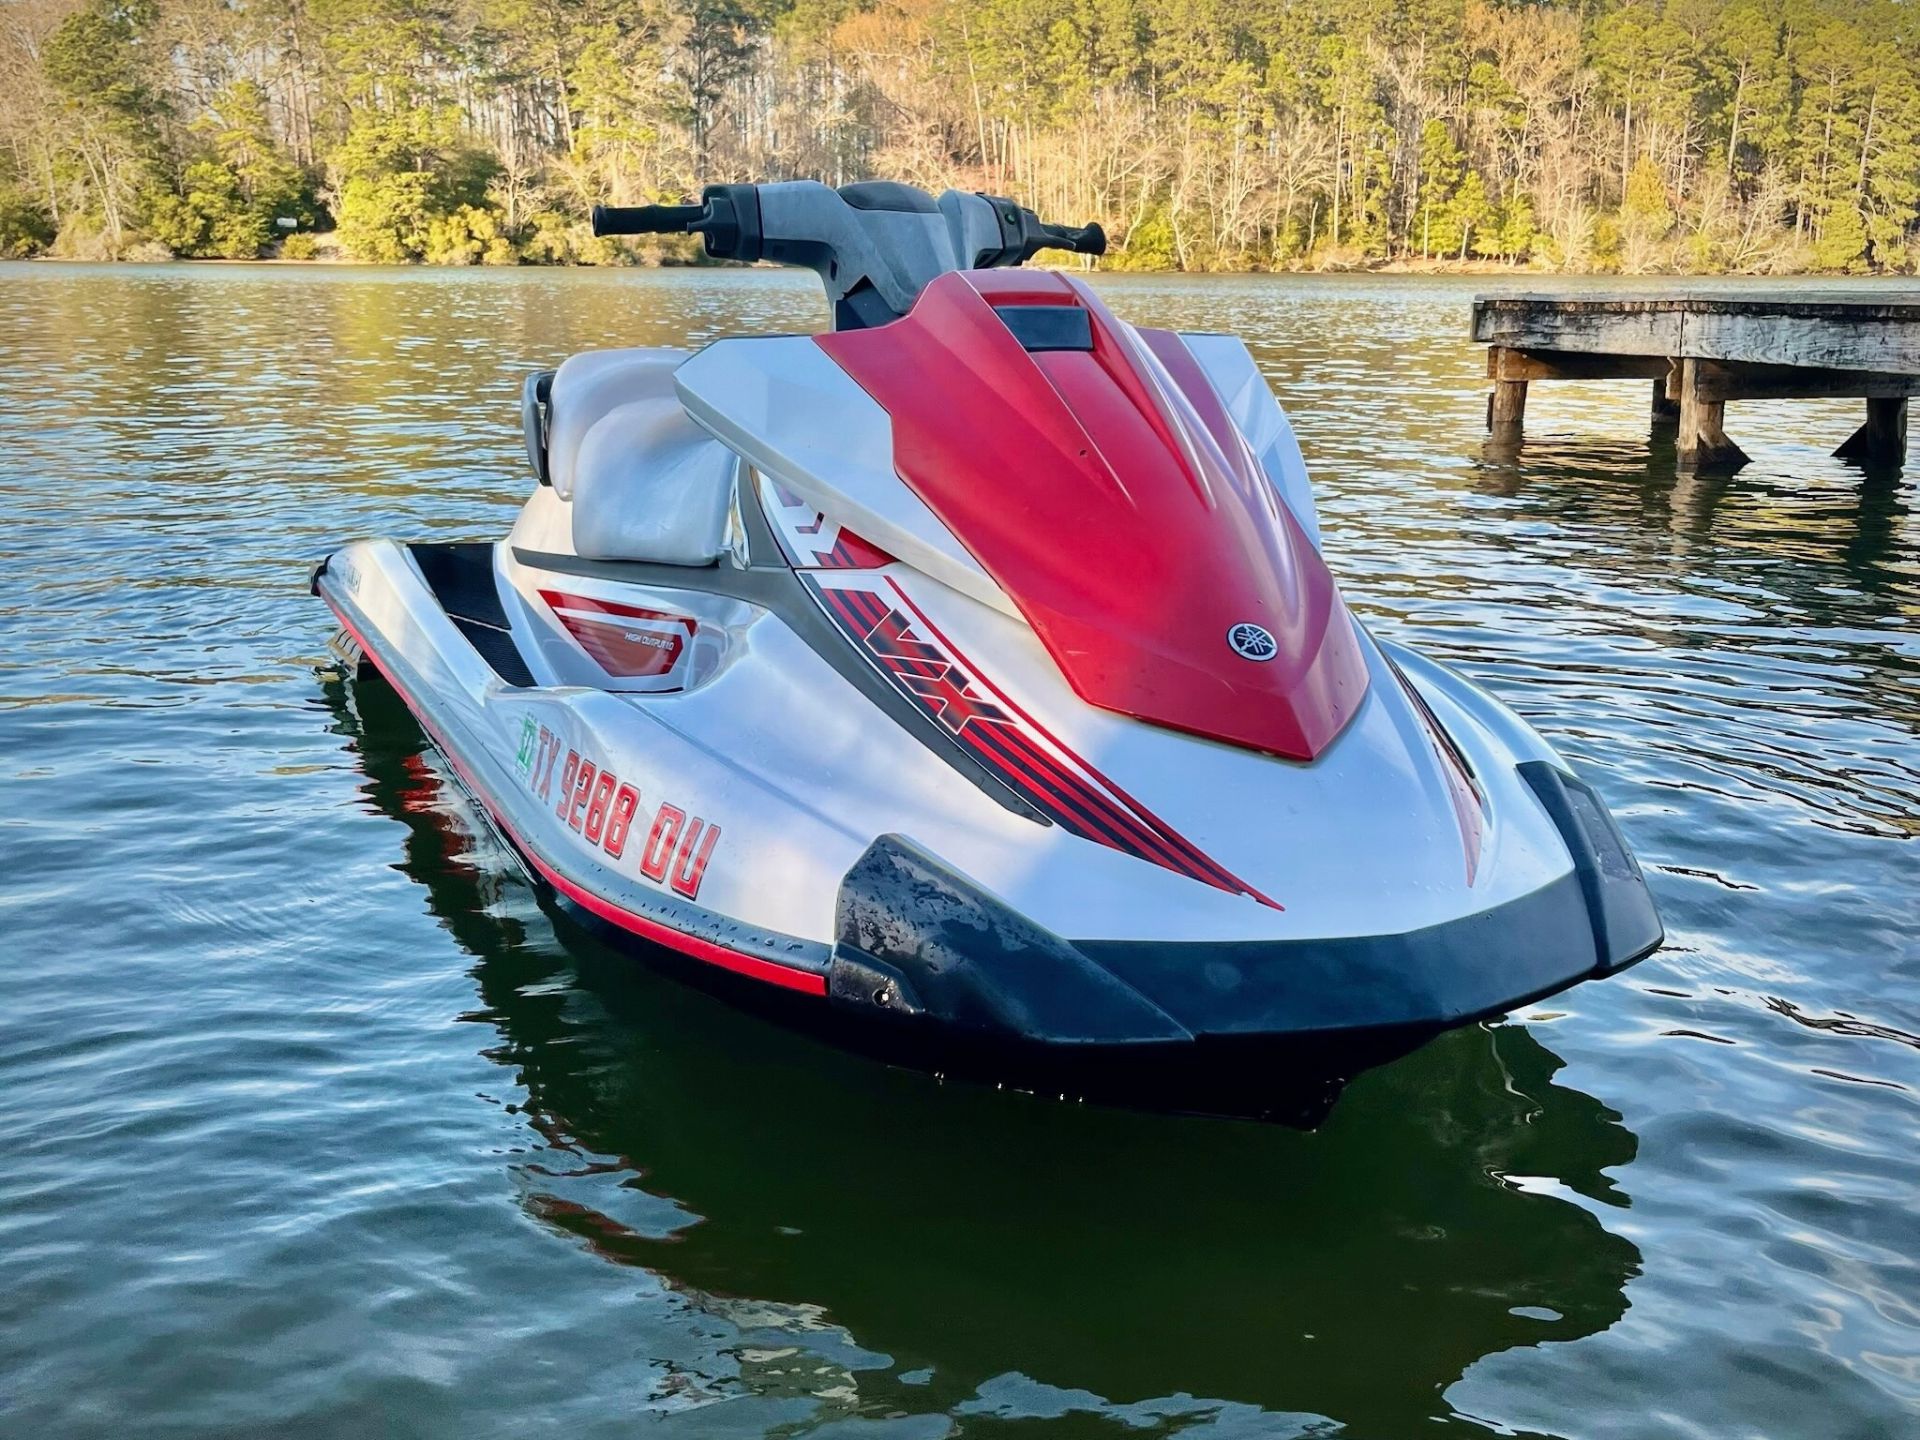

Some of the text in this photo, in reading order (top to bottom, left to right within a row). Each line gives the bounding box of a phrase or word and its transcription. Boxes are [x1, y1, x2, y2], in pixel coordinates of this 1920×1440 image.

[625, 632, 641, 643] HIGH
[864, 609, 1017, 734] VX
[532, 726, 721, 900] TX 9288 OU
